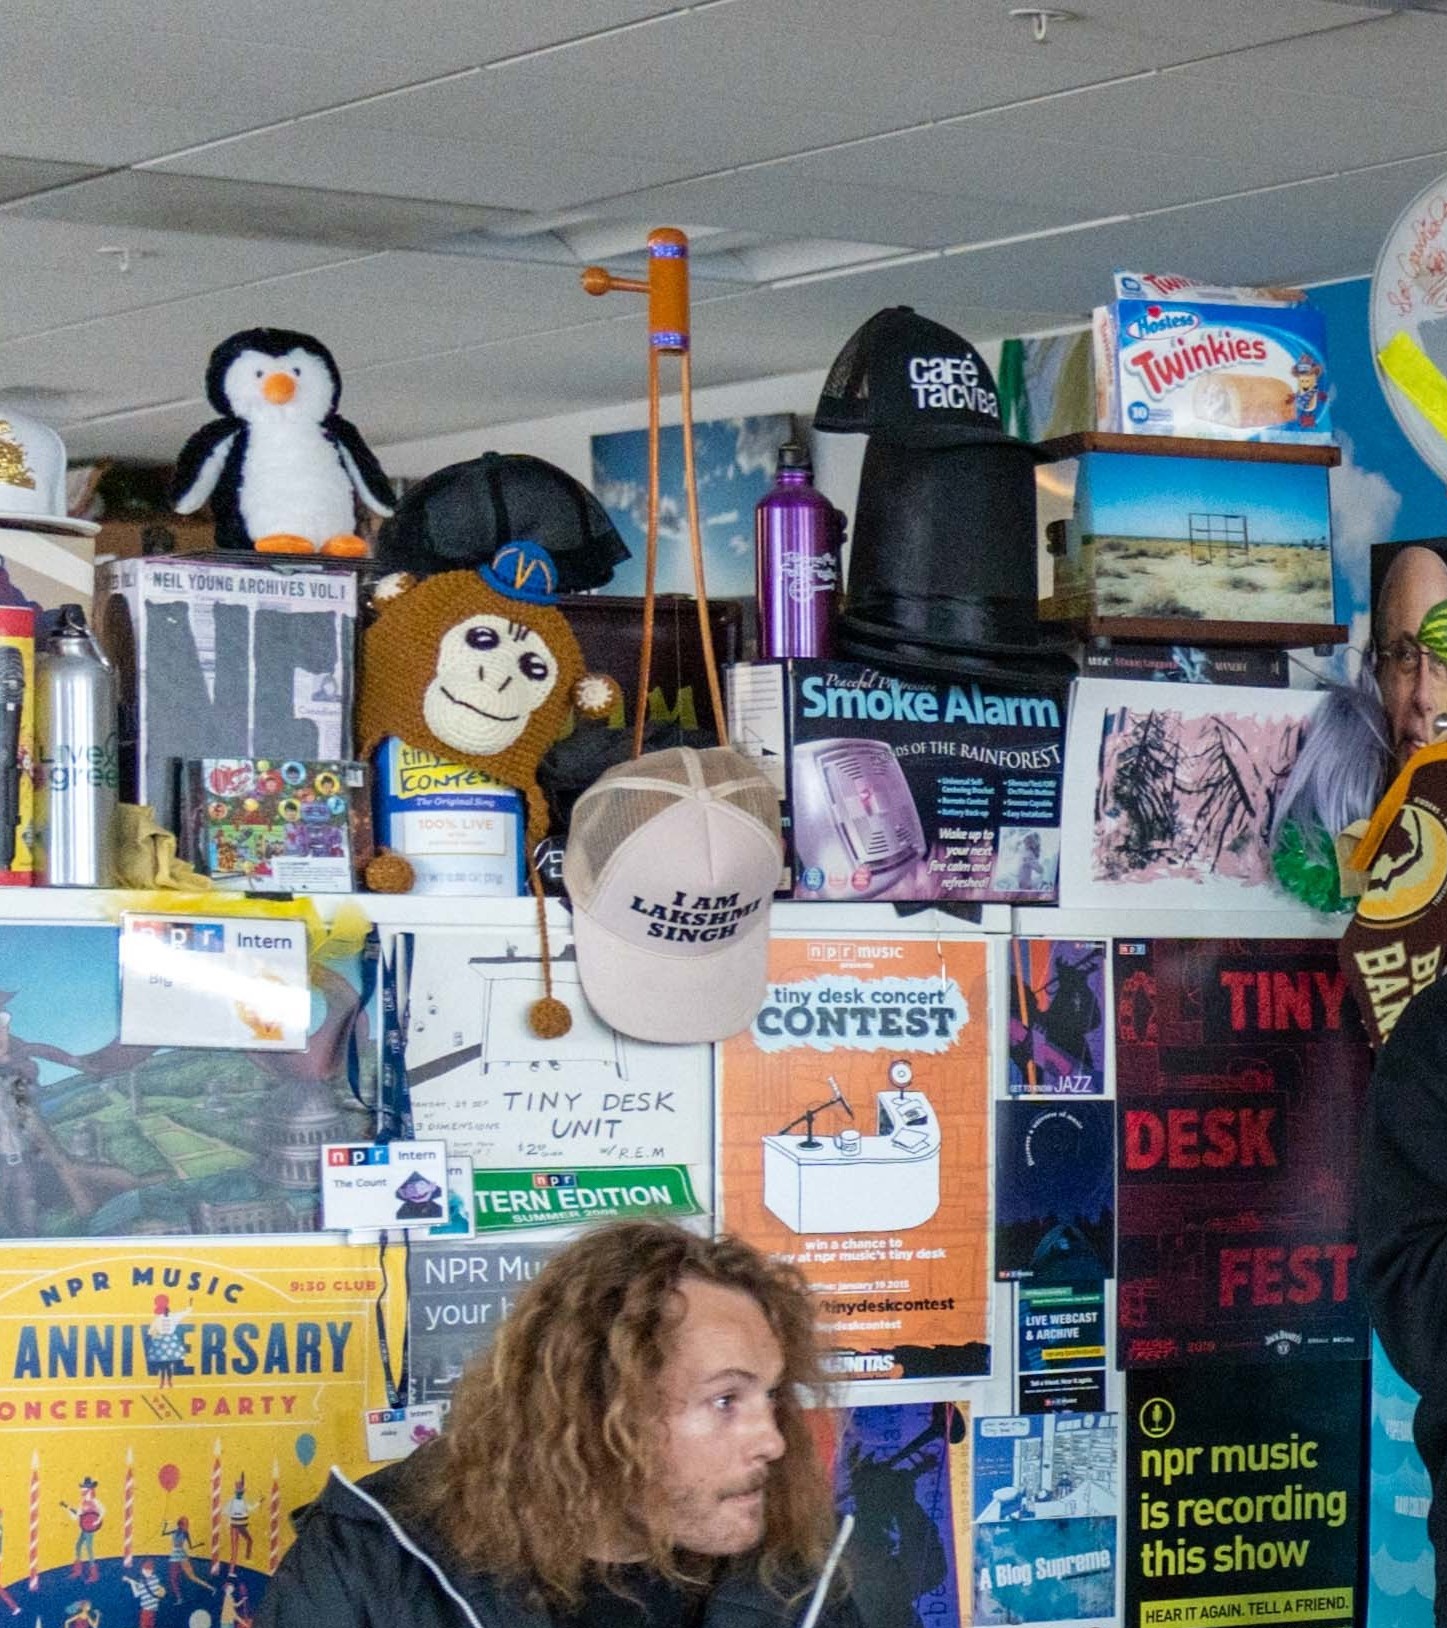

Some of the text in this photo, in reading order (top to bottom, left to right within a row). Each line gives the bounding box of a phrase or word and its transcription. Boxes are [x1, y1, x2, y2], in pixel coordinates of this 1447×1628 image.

[1134, 310, 1196, 338] Hostess
[1130, 334, 1269, 396] Twinkies
[152, 571, 306, 599] NEIL YOUNG ARCHIVES
[802, 676, 1060, 728] Smoke Alarm
[911, 741, 1062, 770] OF THE RAINFOREST
[939, 828, 969, 840] Wake
[945, 845, 992, 858] your next
[631, 894, 761, 927] LAKSHMI
[672, 891, 740, 908] I AM
[237, 931, 293, 949] Intern
[647, 923, 738, 942] SINGH
[810, 944, 904, 961] npr music
[774, 986, 946, 1006] tiny desk concert
[1220, 968, 1351, 1032] TINY
[756, 1005, 958, 1038] CONTEST
[1053, 1074, 1092, 1093] JAZZ
[503, 1091, 675, 1112] TINY DESK
[552, 1117, 622, 1140] UNIT
[1124, 1108, 1276, 1171] DESK
[333, 1148, 437, 1166] npr Intern
[333, 1177, 388, 1189] The Count
[534, 1173, 576, 1187] npr
[563, 1184, 673, 1211] EDITION
[512, 1210, 582, 1224] SUMMER
[805, 1238, 886, 1250] win chance
[813, 1250, 946, 1265] npr music's tiny desk
[424, 1258, 487, 1283] NPR
[1219, 1243, 1358, 1307] FEST
[38, 1266, 245, 1308] NPR MUSIC
[289, 1279, 377, 1293] 9:30 CLUB
[424, 1301, 491, 1330] your
[1025, 1311, 1098, 1327] LIVE WEBCAST
[1036, 1327, 1080, 1340] ARCHIVE
[190, 1395, 298, 1417] PARTY
[1140, 1431, 1319, 1486] npr music
[1140, 1484, 1348, 1531] is recording
[1140, 1534, 1311, 1579] this show
[979, 1547, 1112, 1590] A Blog Supreme
[1145, 1596, 1350, 1624] HEAR IT AGAIN. TELL A FRIEND.
